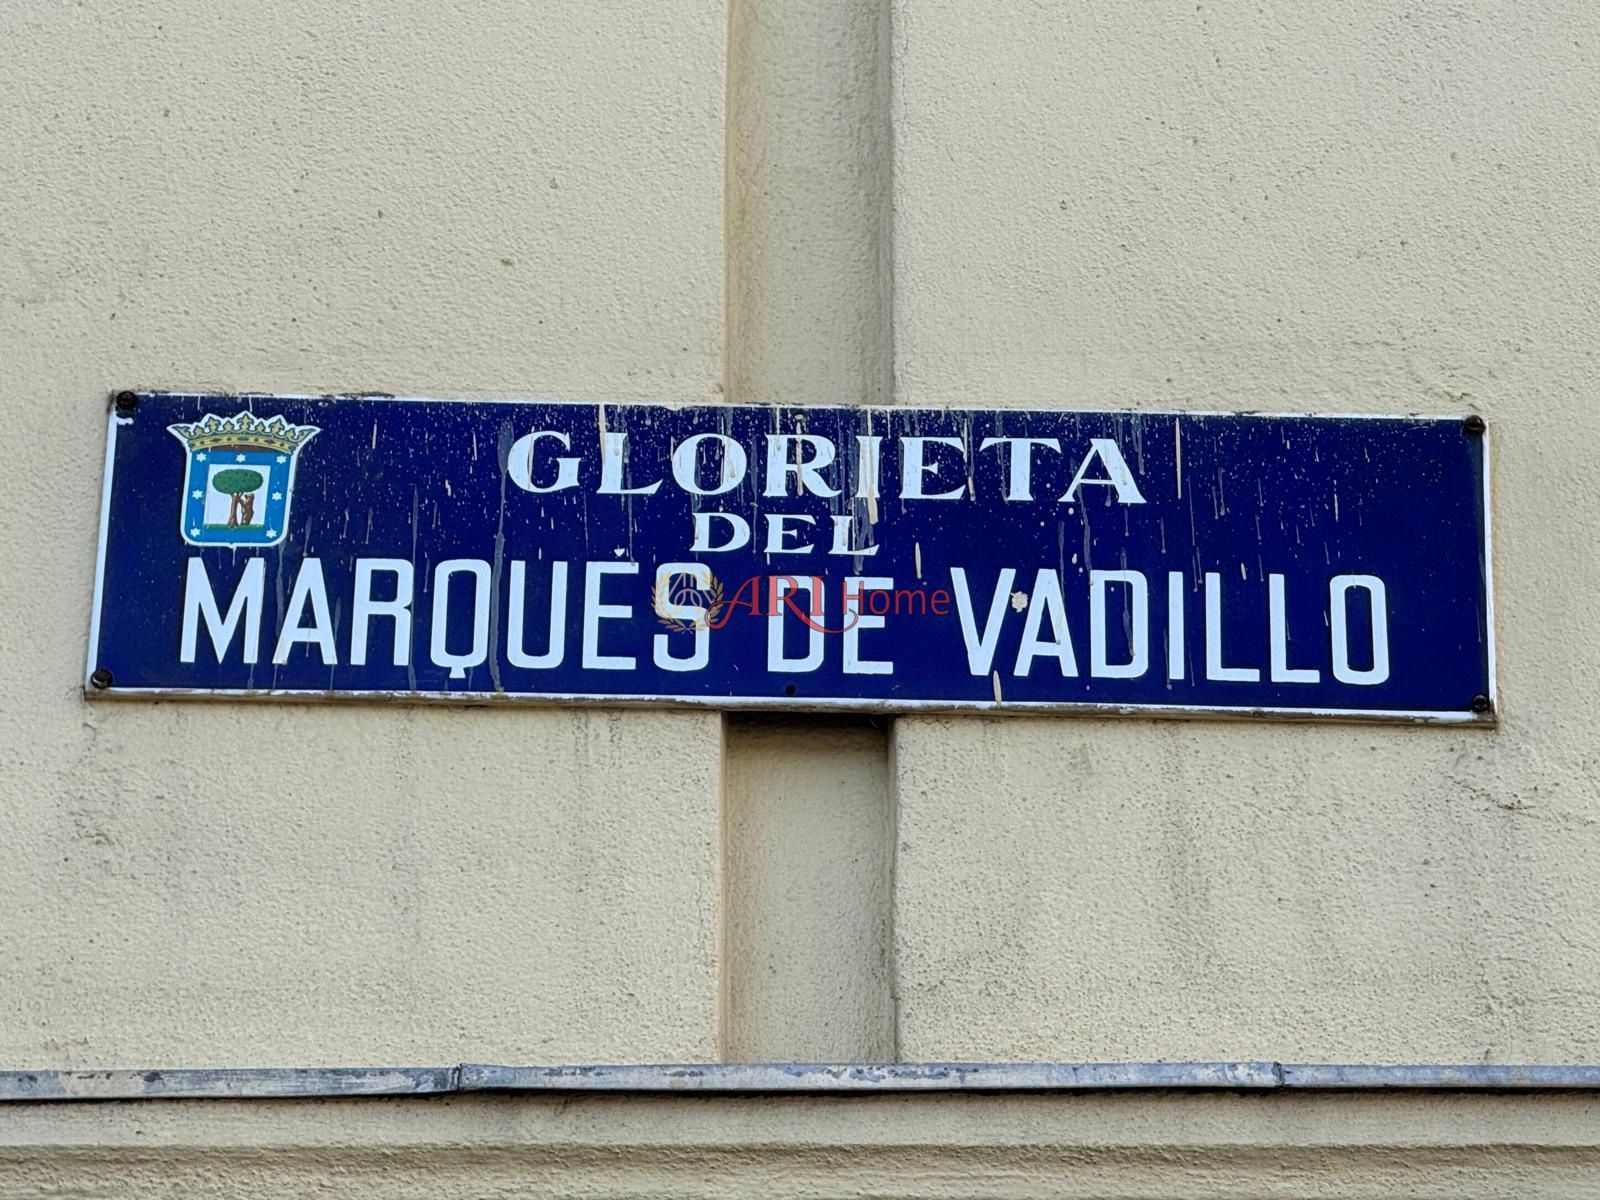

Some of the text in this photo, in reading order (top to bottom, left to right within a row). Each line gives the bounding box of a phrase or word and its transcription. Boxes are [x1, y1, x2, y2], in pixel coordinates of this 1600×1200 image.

[507, 429, 1147, 505] GLORIETA
[689, 512, 880, 557] DEL
[766, 574, 895, 675] DE
[949, 566, 1391, 686] VADILLO
